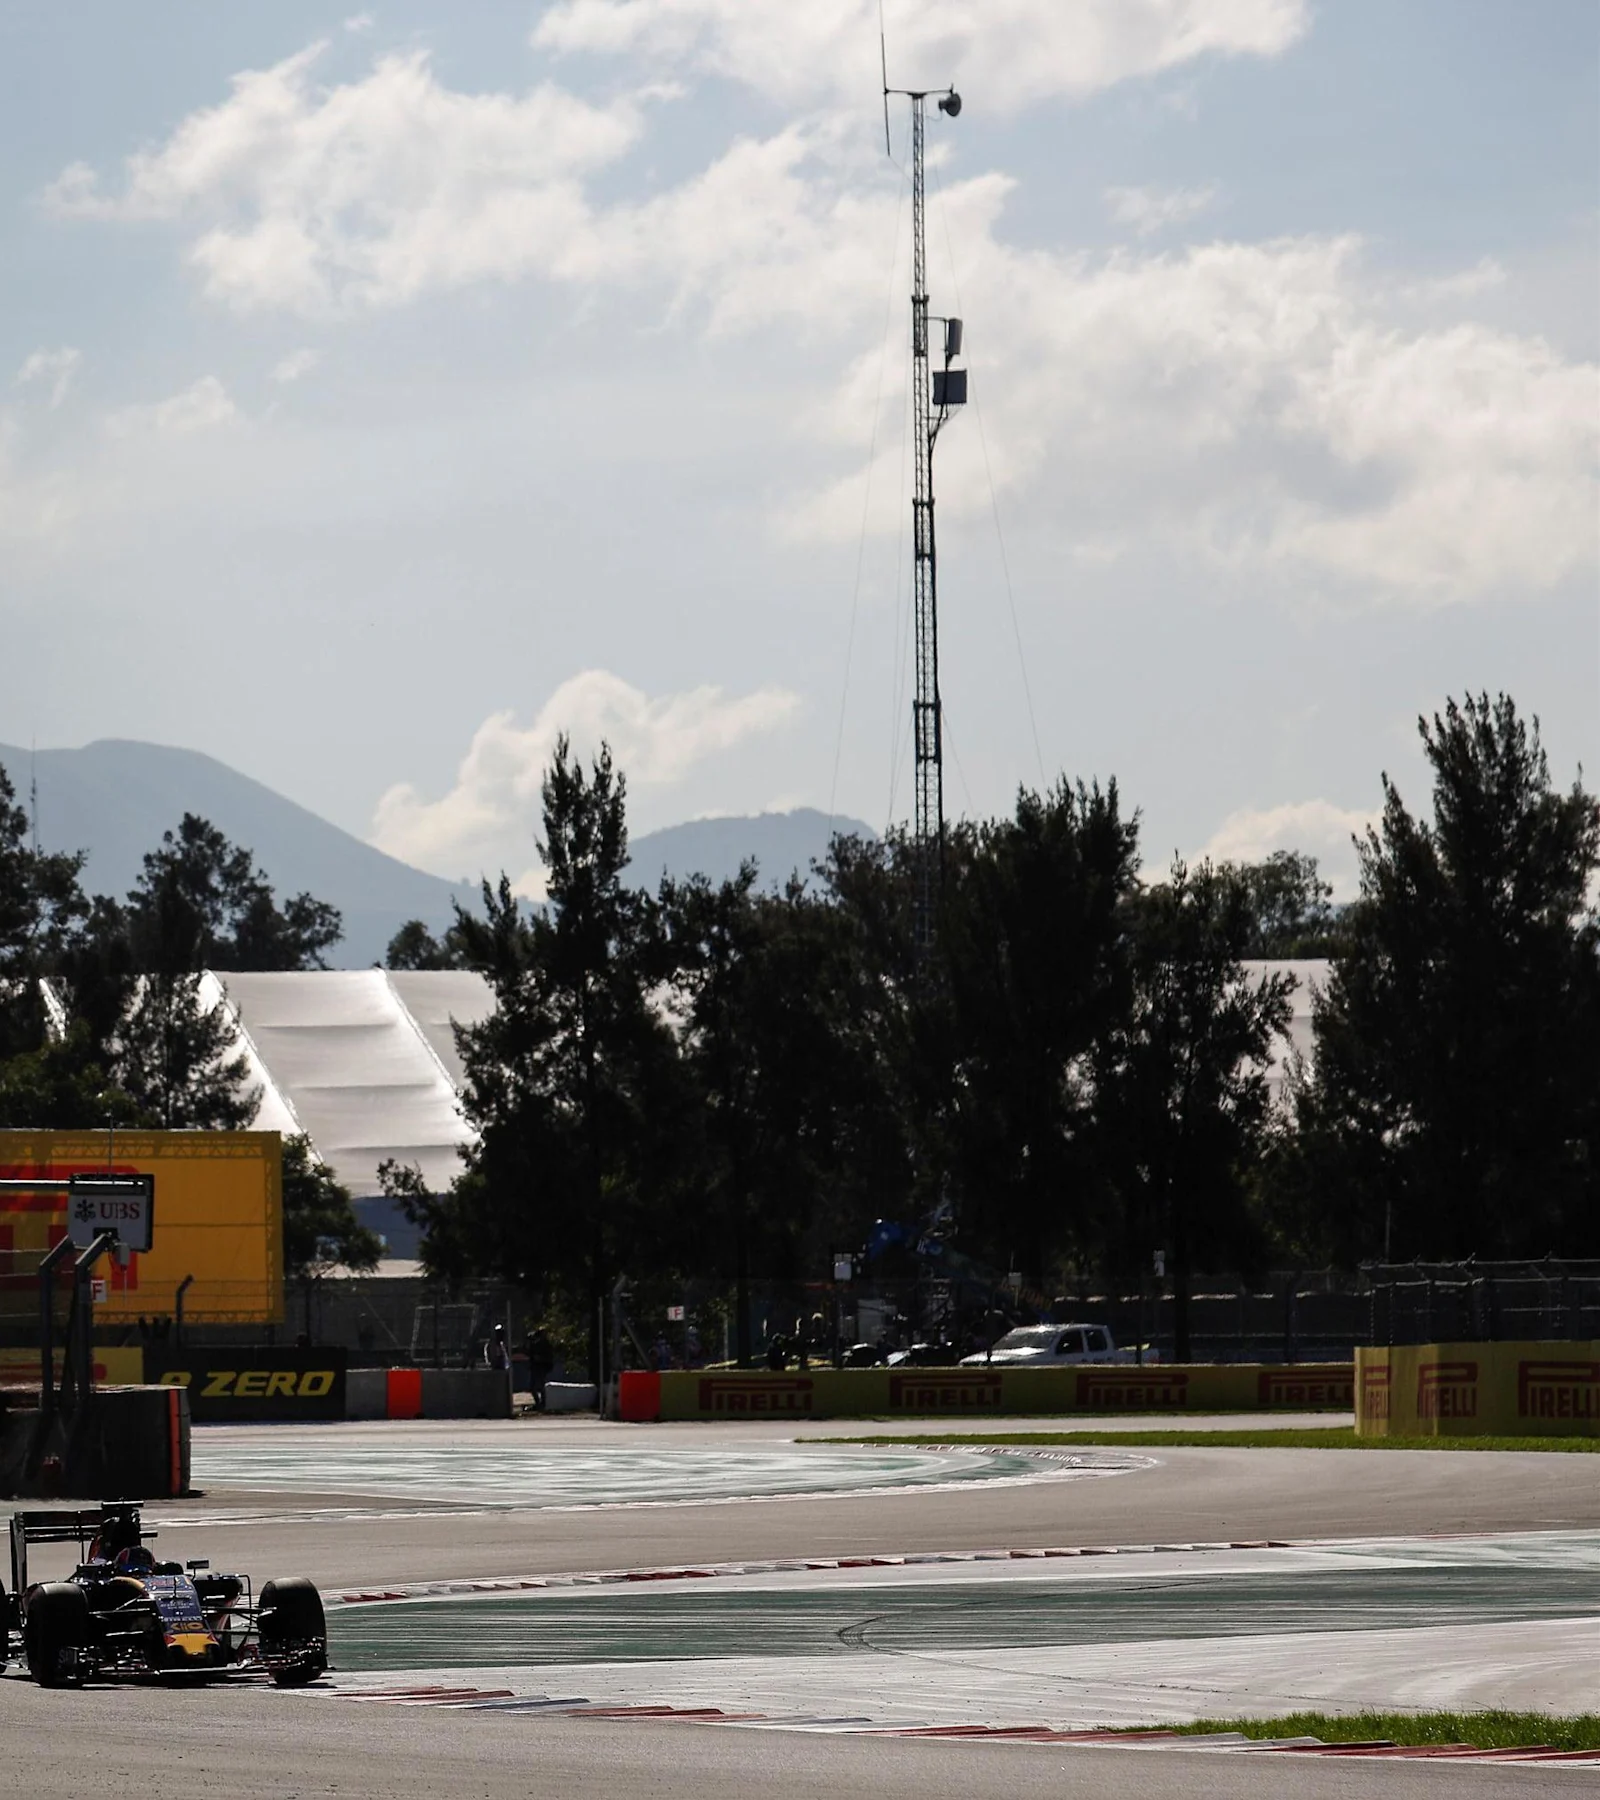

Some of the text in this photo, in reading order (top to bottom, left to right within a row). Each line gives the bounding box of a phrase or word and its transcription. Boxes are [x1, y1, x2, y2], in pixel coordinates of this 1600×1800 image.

[100, 1202, 140, 1220] UBS
[92, 1282, 103, 1300] F
[200, 1370, 336, 1397] ZERO
[699, 1378, 814, 1411] PIRELLI
[890, 1373, 1003, 1408] PIRELLI
[1077, 1374, 1189, 1406] PIRELLI
[1258, 1371, 1355, 1403] PIRELL
[1418, 1362, 1478, 1419] PIRELLI
